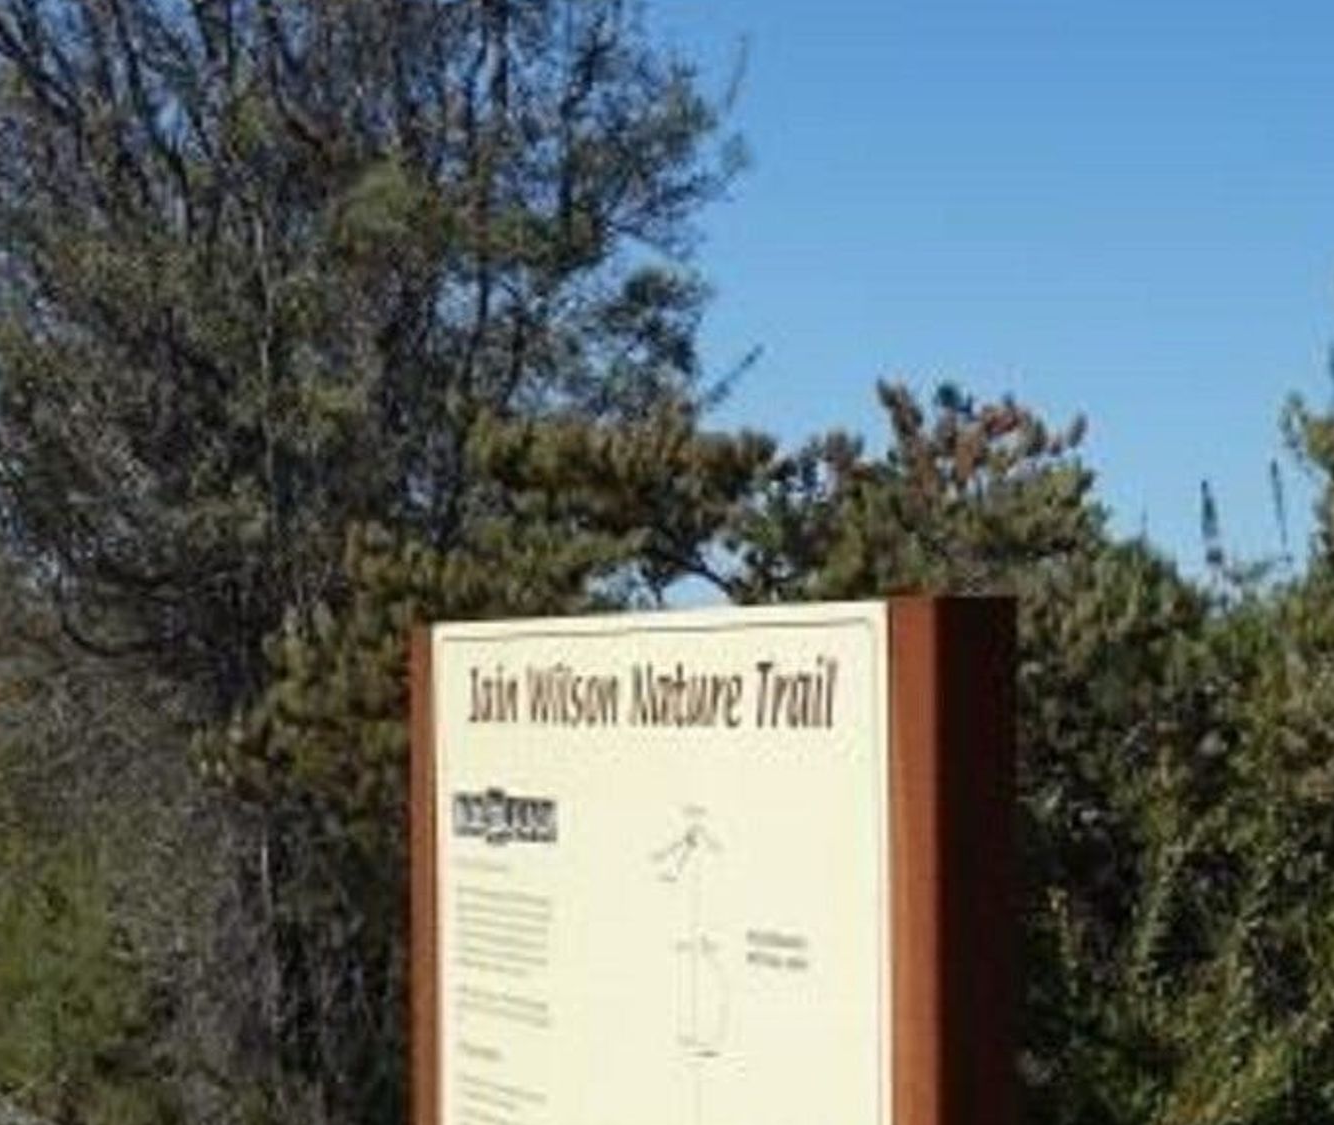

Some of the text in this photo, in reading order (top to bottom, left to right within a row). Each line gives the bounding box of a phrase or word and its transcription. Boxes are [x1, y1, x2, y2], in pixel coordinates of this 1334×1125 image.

[467, 655, 838, 729] Iain Wilson Nature Trail
